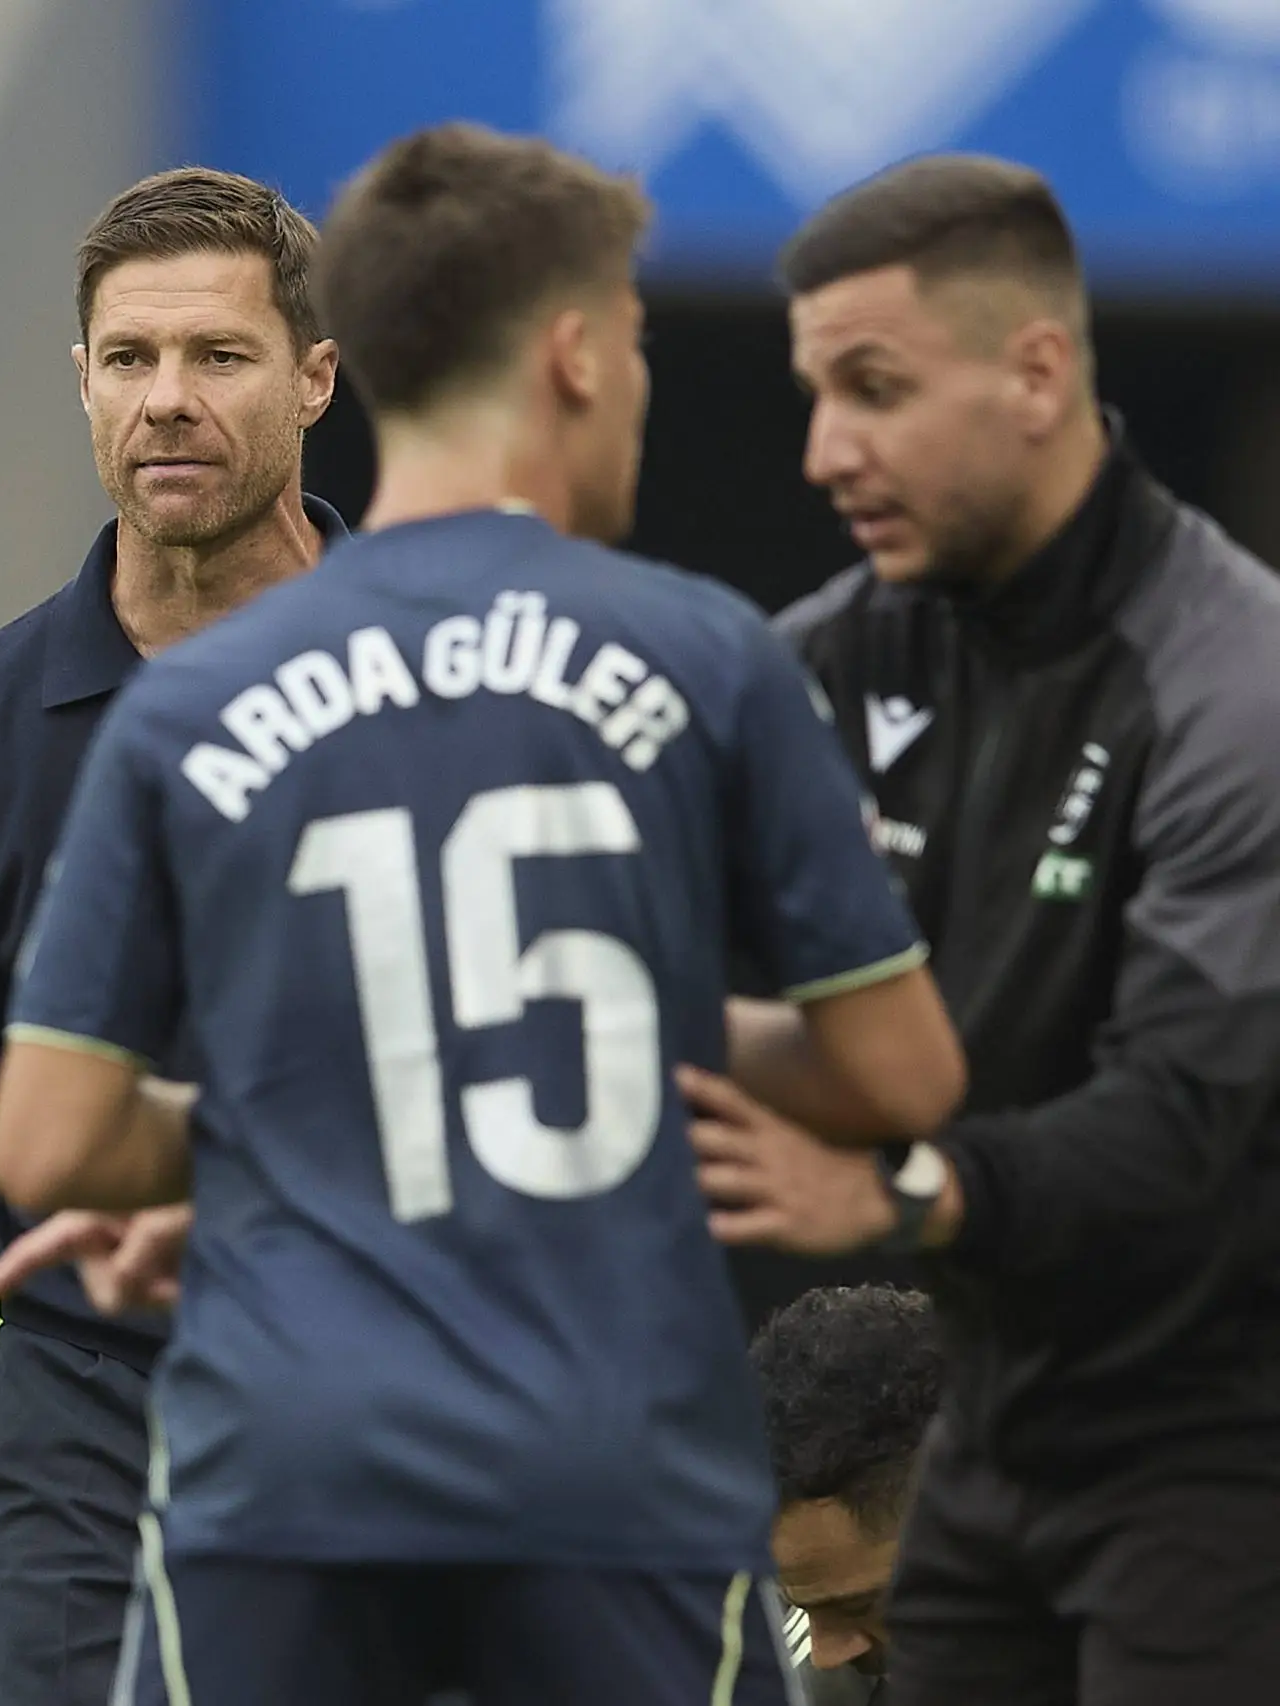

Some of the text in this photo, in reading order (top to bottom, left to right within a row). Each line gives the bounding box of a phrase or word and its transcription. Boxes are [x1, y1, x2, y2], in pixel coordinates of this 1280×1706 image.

[180, 590, 690, 823] ARDA GÜLER
[287, 781, 663, 1225] 15
